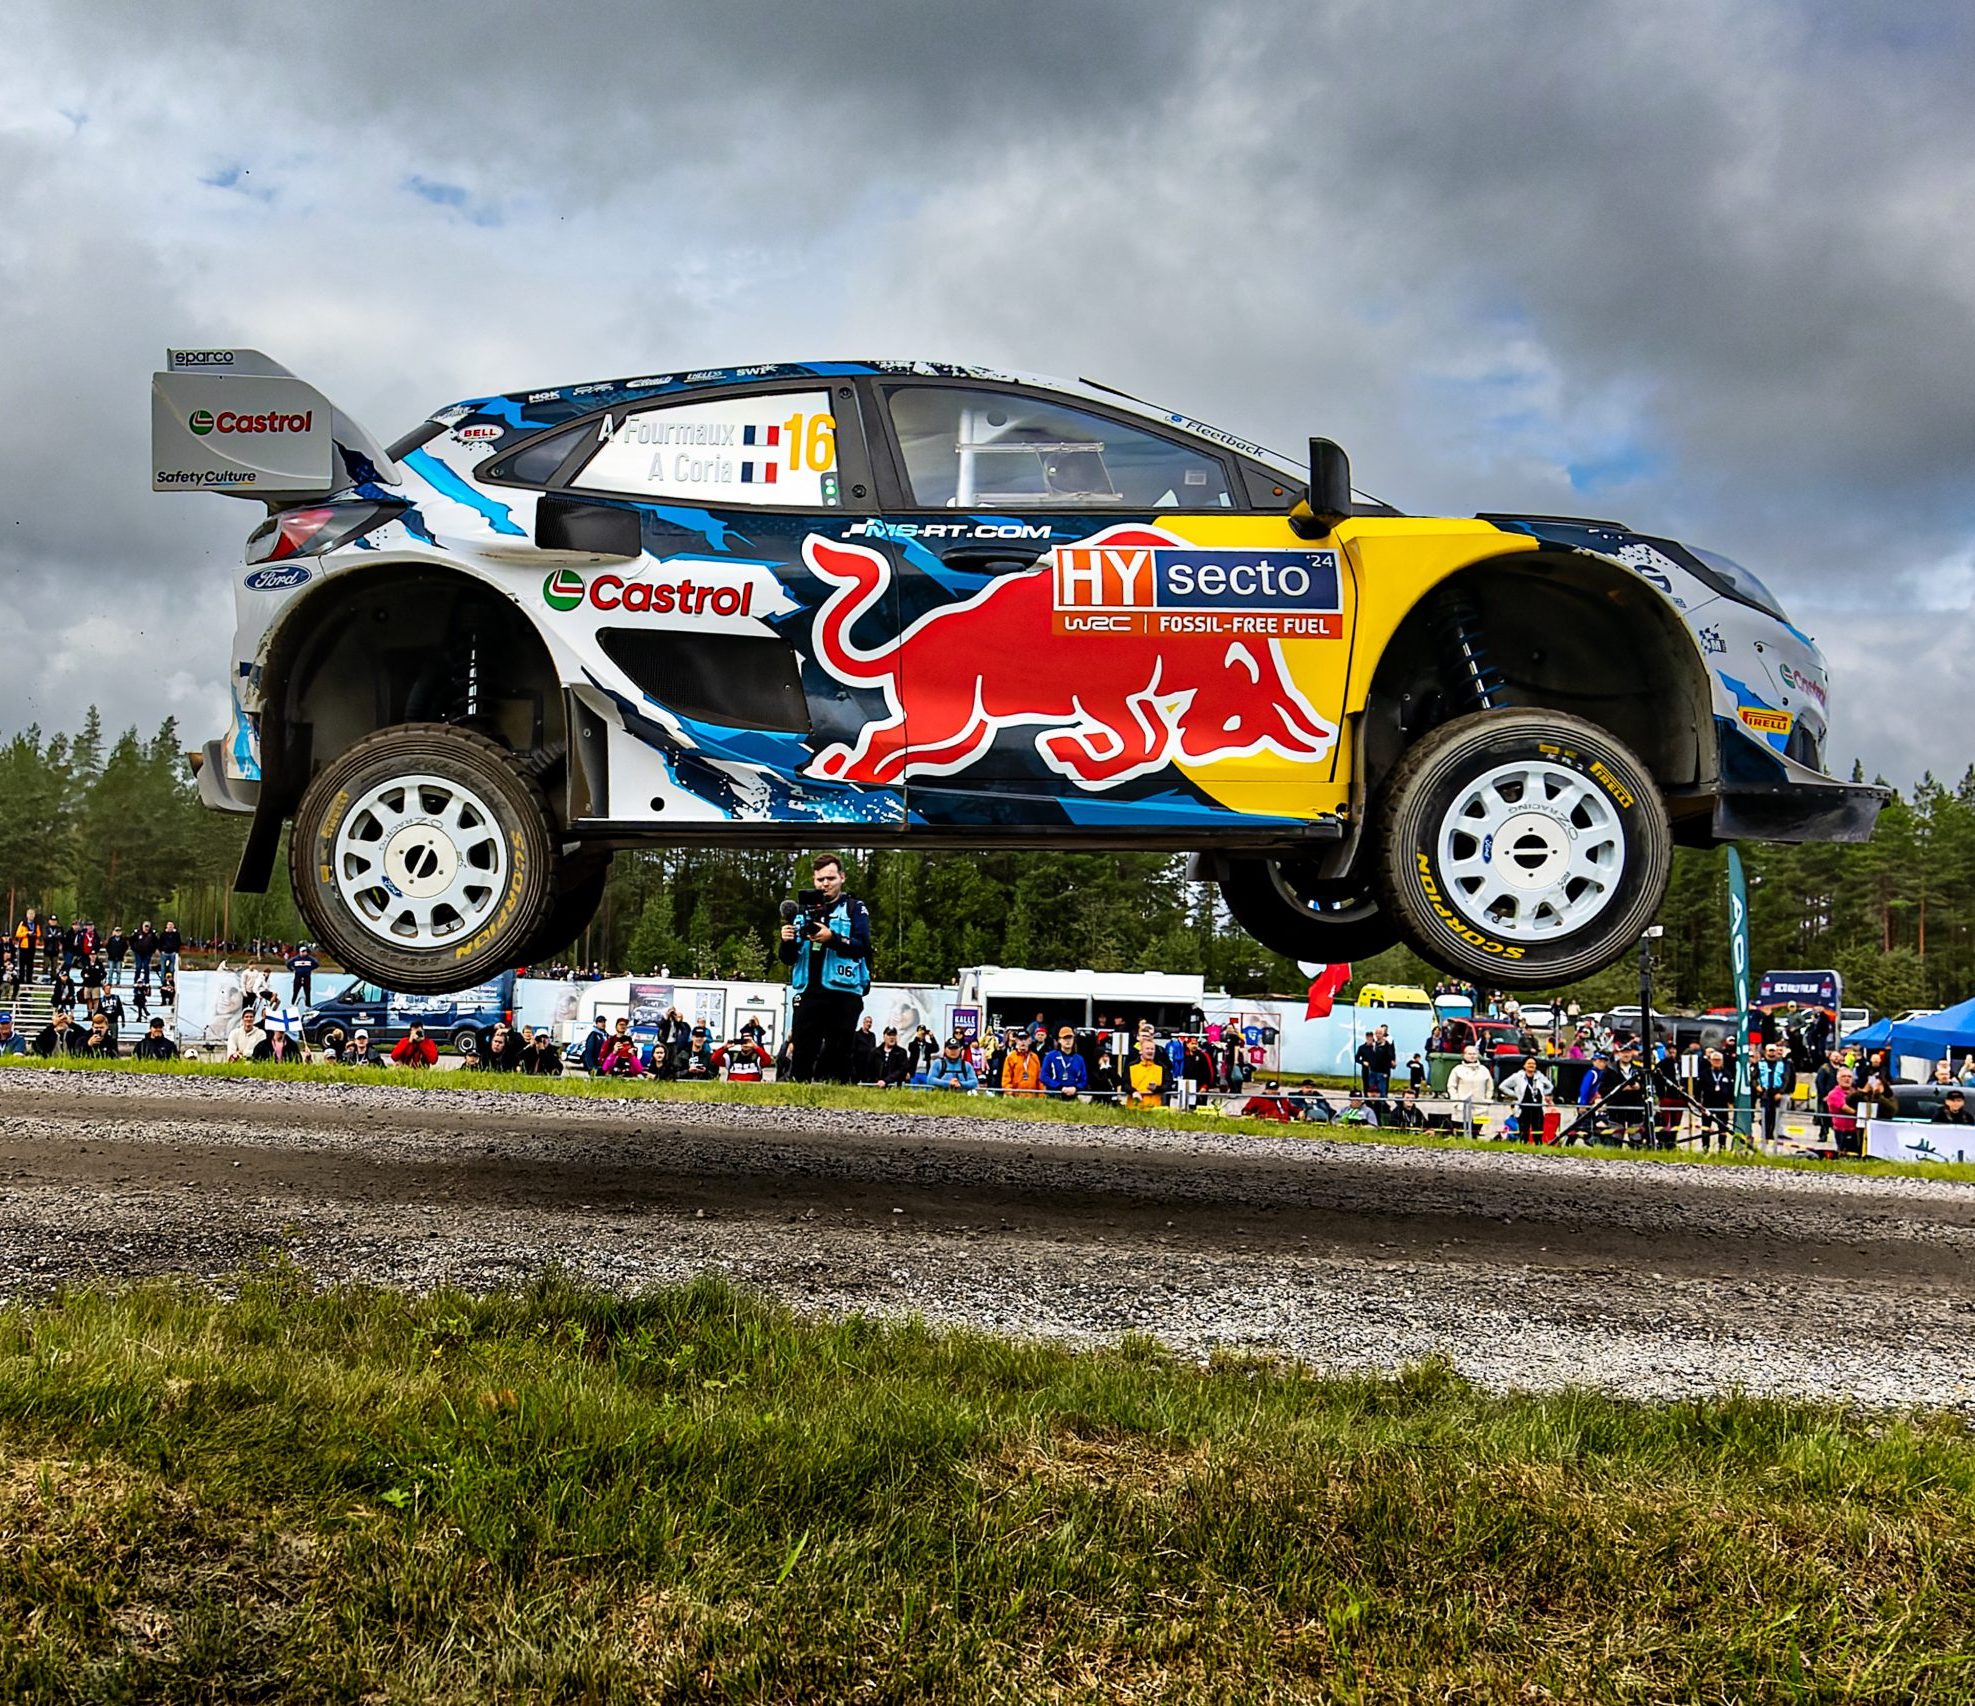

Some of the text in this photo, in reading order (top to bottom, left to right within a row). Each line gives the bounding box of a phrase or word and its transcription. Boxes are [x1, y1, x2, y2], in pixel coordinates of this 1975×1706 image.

[175, 351, 234, 366] sparco
[528, 390, 560, 400] NGK
[216, 411, 312, 433] Castrol
[464, 429, 497, 437] BELL
[598, 414, 734, 446] A Fourmaux
[784, 413, 837, 472] 16
[1185, 421, 1265, 457] Fleetback
[648, 452, 732, 482] A Coria
[864, 523, 1051, 538] MS-RT.COM
[253, 567, 301, 589] Ford
[1062, 551, 1148, 606] HY
[1168, 560, 1311, 596] secto
[589, 574, 754, 617] Castrol
[1065, 616, 1330, 635] WRC FOSSIL-FREE FUEL
[1742, 711, 1788, 730] PIRELLI
[1589, 760, 1635, 808] PIRELLI
[455, 831, 525, 960] SCORPION
[1417, 853, 1525, 959] SCORPION
